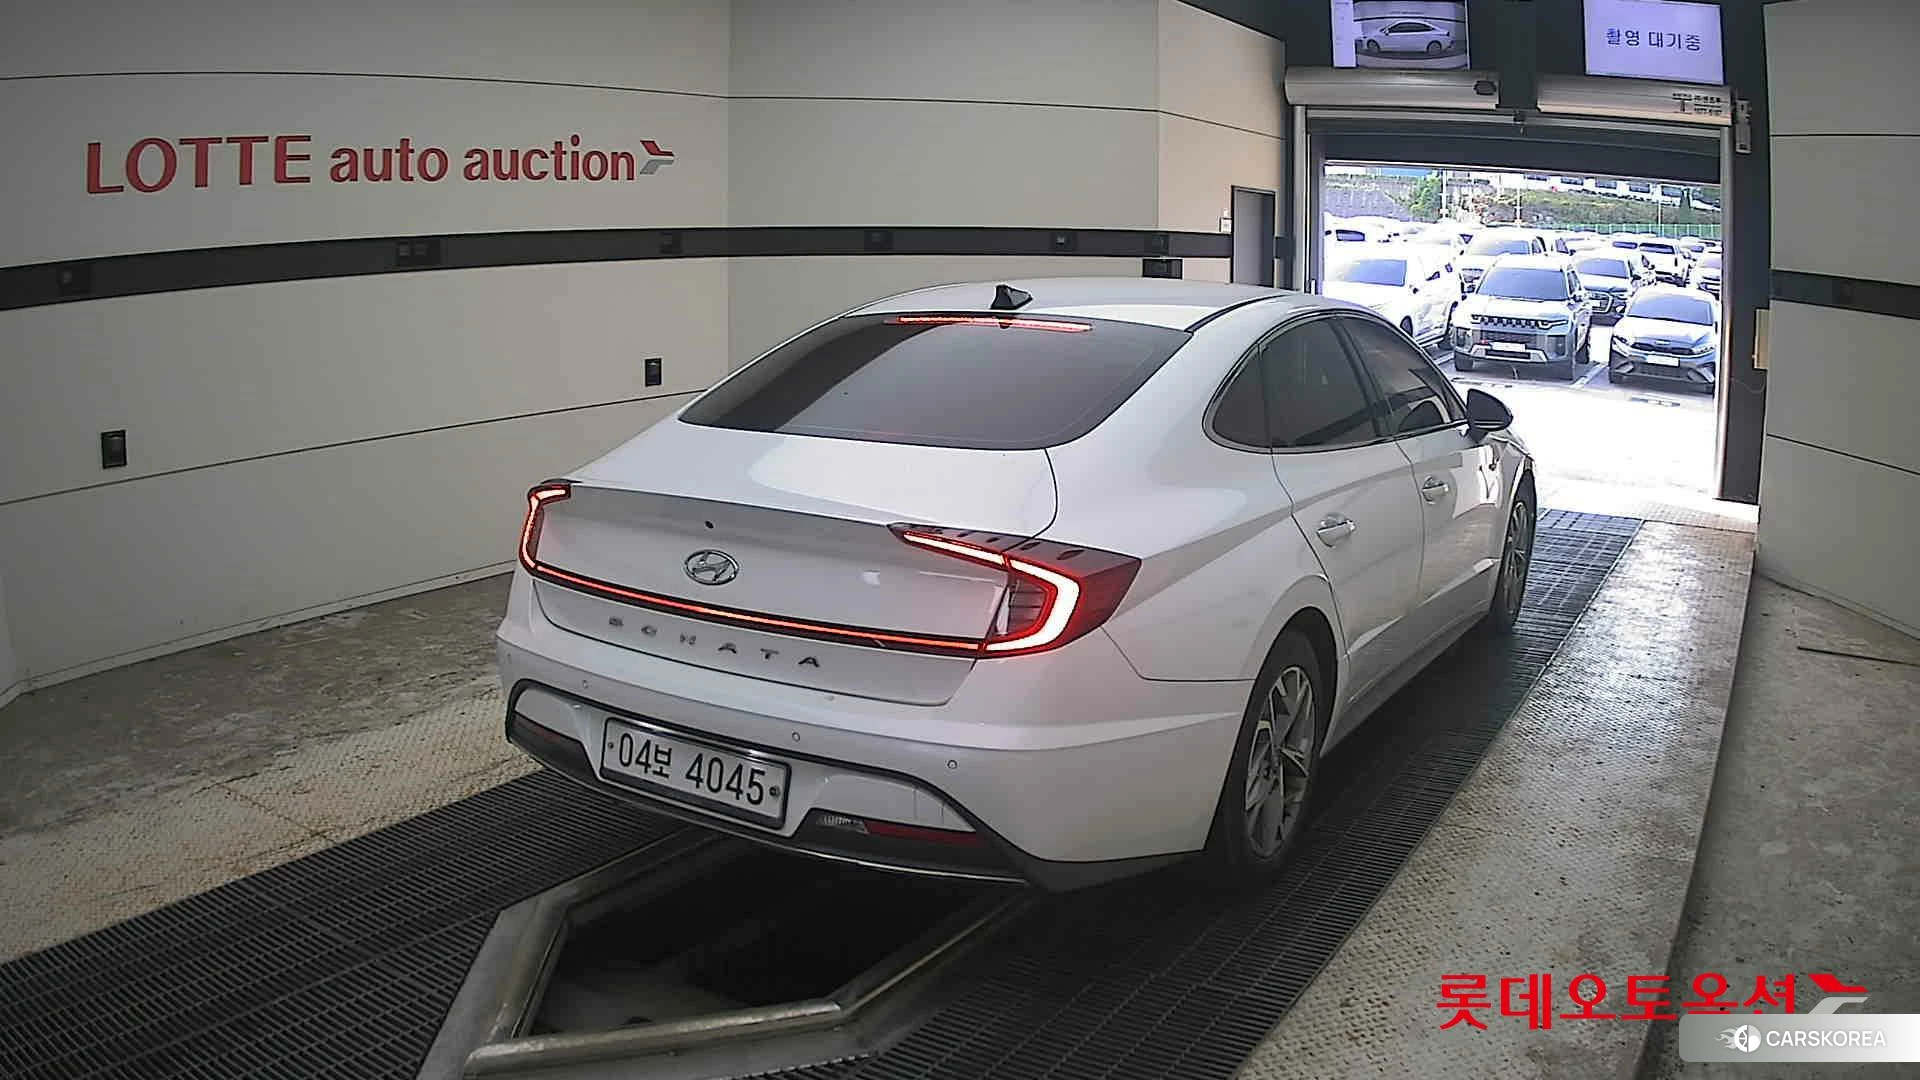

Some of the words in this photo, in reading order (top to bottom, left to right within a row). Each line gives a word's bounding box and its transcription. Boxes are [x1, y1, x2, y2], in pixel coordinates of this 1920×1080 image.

[1606, 28, 1640, 47] 촬영
[1648, 31, 1701, 51] 대기중
[86, 135, 312, 194] LOTTE
[329, 137, 449, 183] auto
[463, 134, 635, 182] auction
[608, 616, 820, 669] SONATA
[618, 732, 673, 779] 04보
[685, 753, 766, 806] 4045
